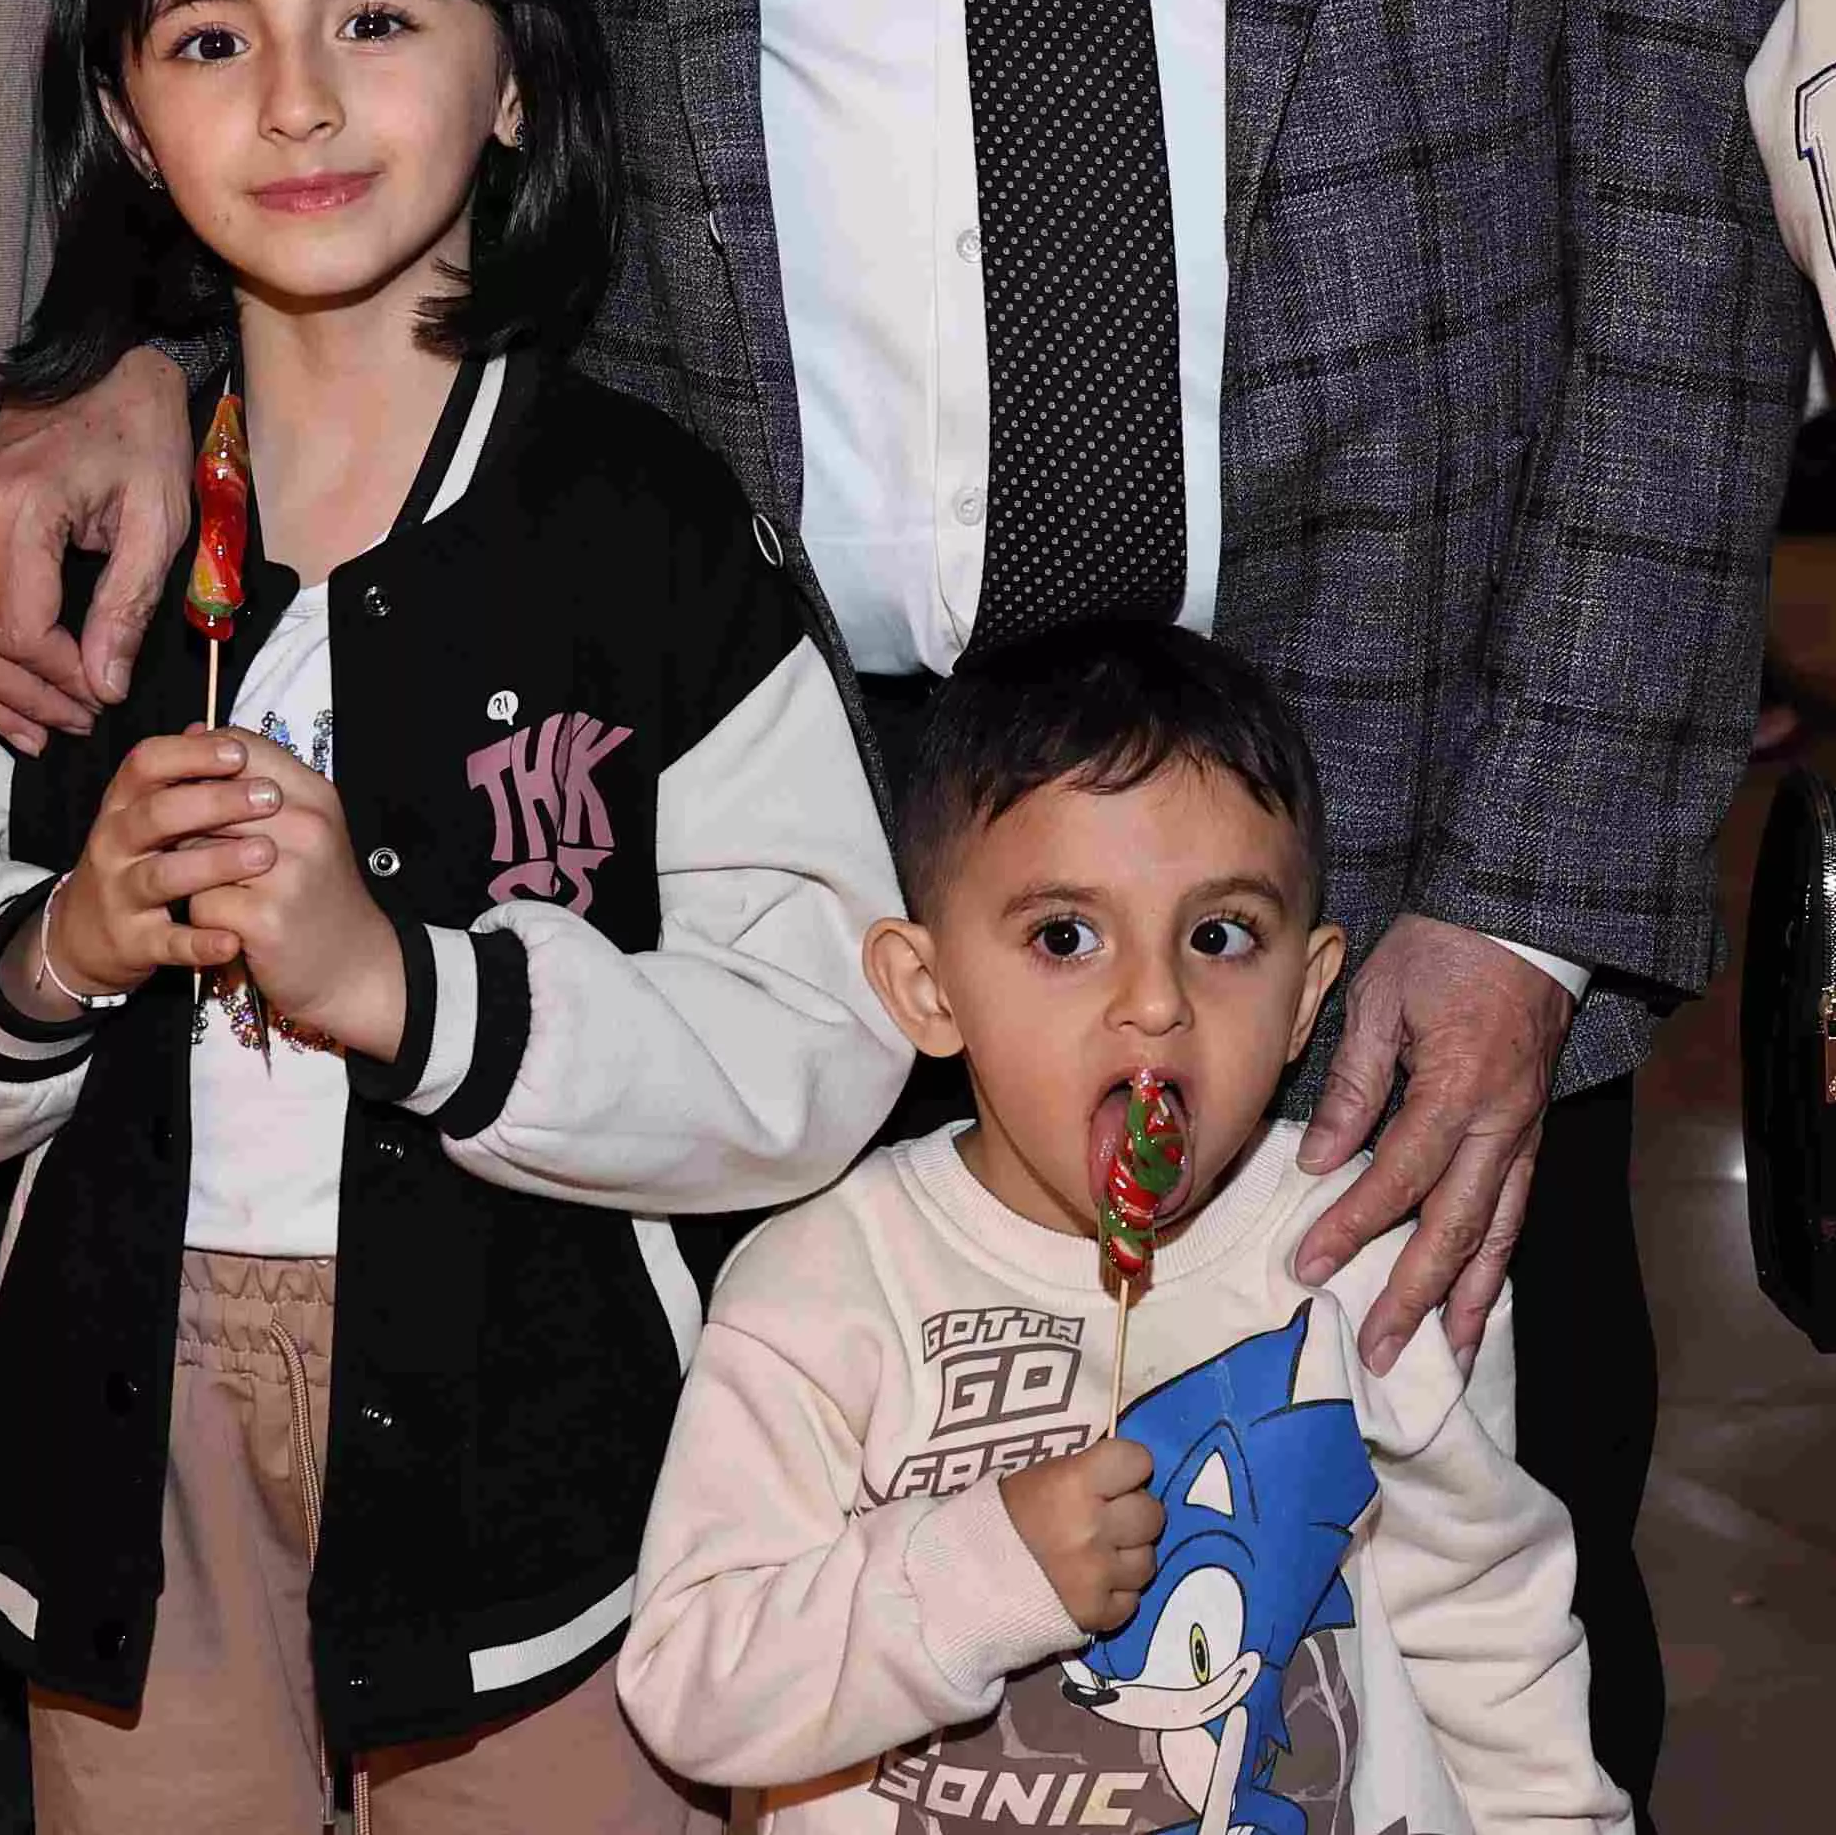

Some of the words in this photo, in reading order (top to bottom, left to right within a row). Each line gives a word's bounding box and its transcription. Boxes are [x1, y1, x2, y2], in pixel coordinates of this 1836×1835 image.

[921, 1306, 1086, 1364] GOTTA
[927, 1342, 1083, 1441] GO
[877, 1754, 1150, 1827] SONIC
